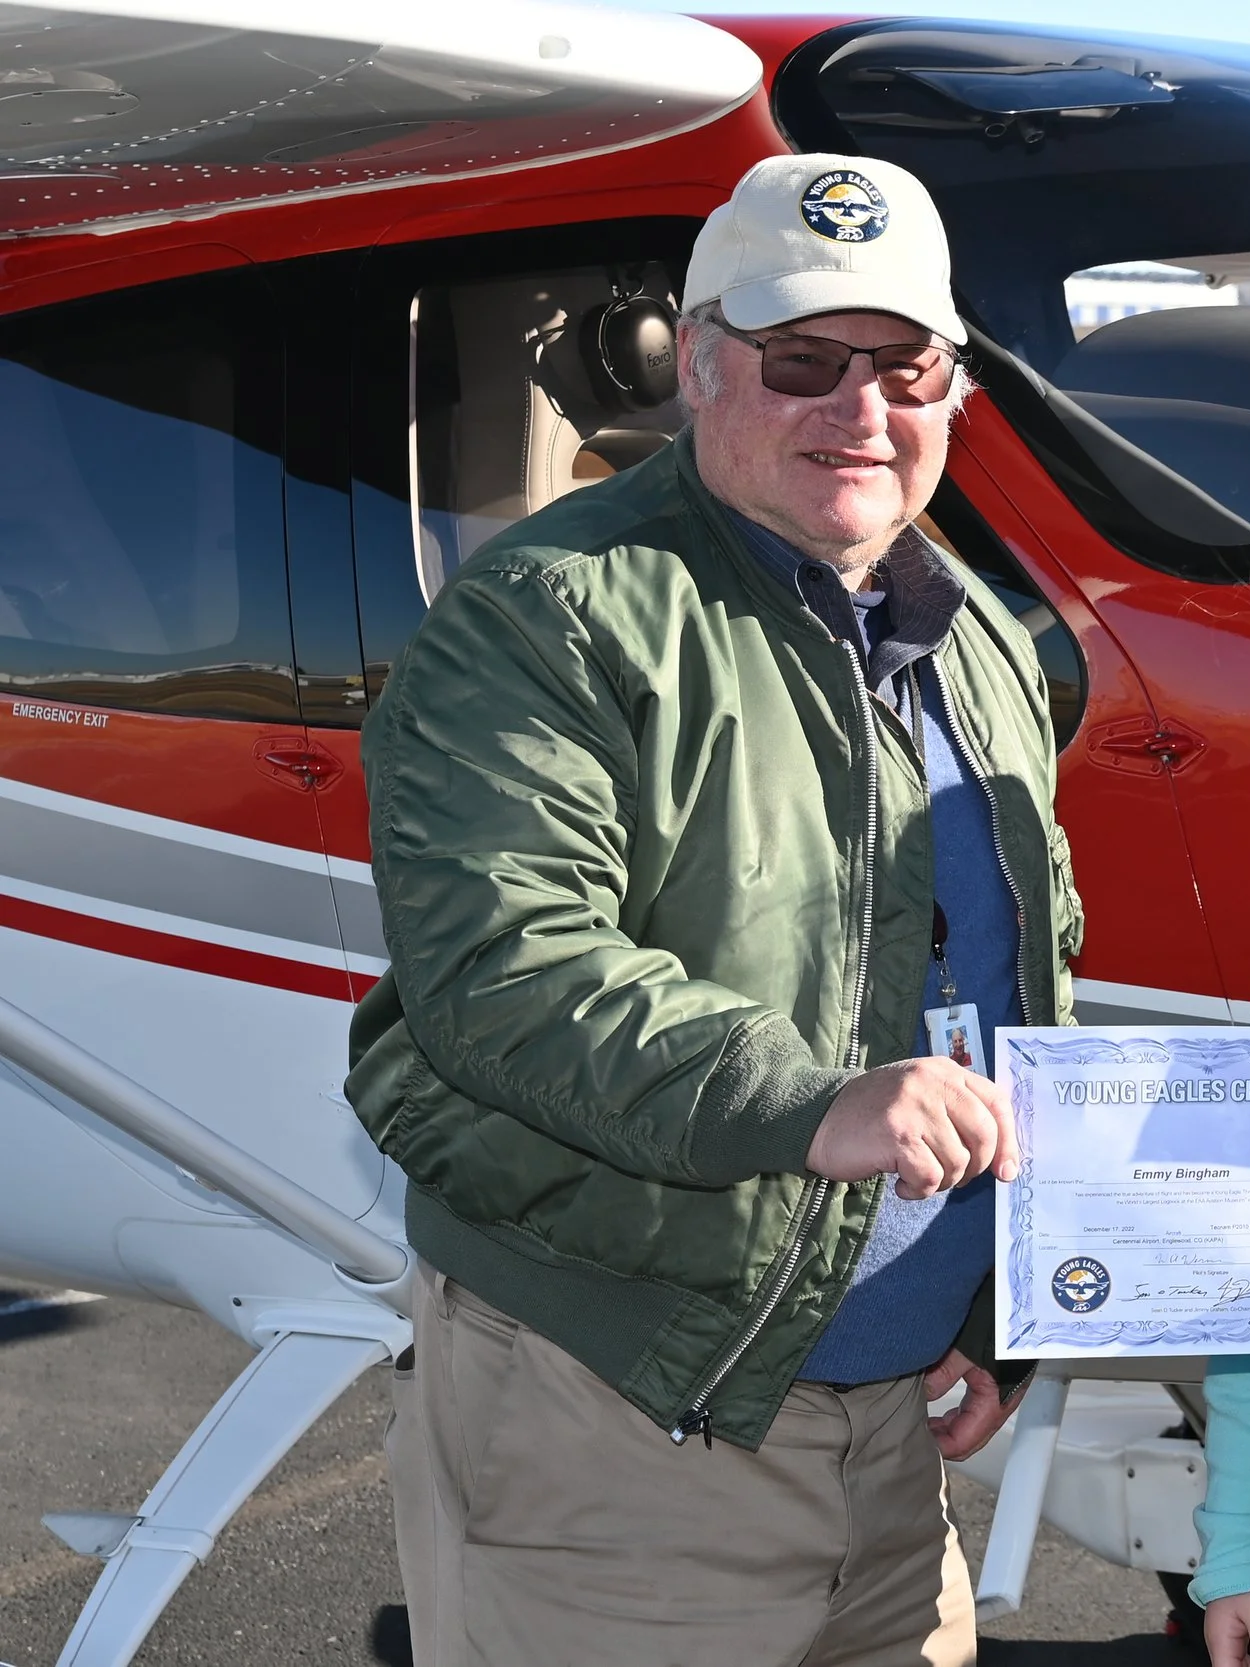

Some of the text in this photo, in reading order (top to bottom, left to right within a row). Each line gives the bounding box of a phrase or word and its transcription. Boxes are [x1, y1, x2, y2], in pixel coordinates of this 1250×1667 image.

[809, 173, 882, 202] YOUNG EAGLES
[836, 232, 859, 241] EAA
[12, 703, 109, 728] EMERGENCY EXIT
[1053, 1080, 1136, 1104] YOUNG
[1140, 1079, 1226, 1103] EAGLES
[1133, 1168, 1230, 1182] Emmy Bingham
[1057, 1259, 1106, 1279] YOUNG EAGLES
